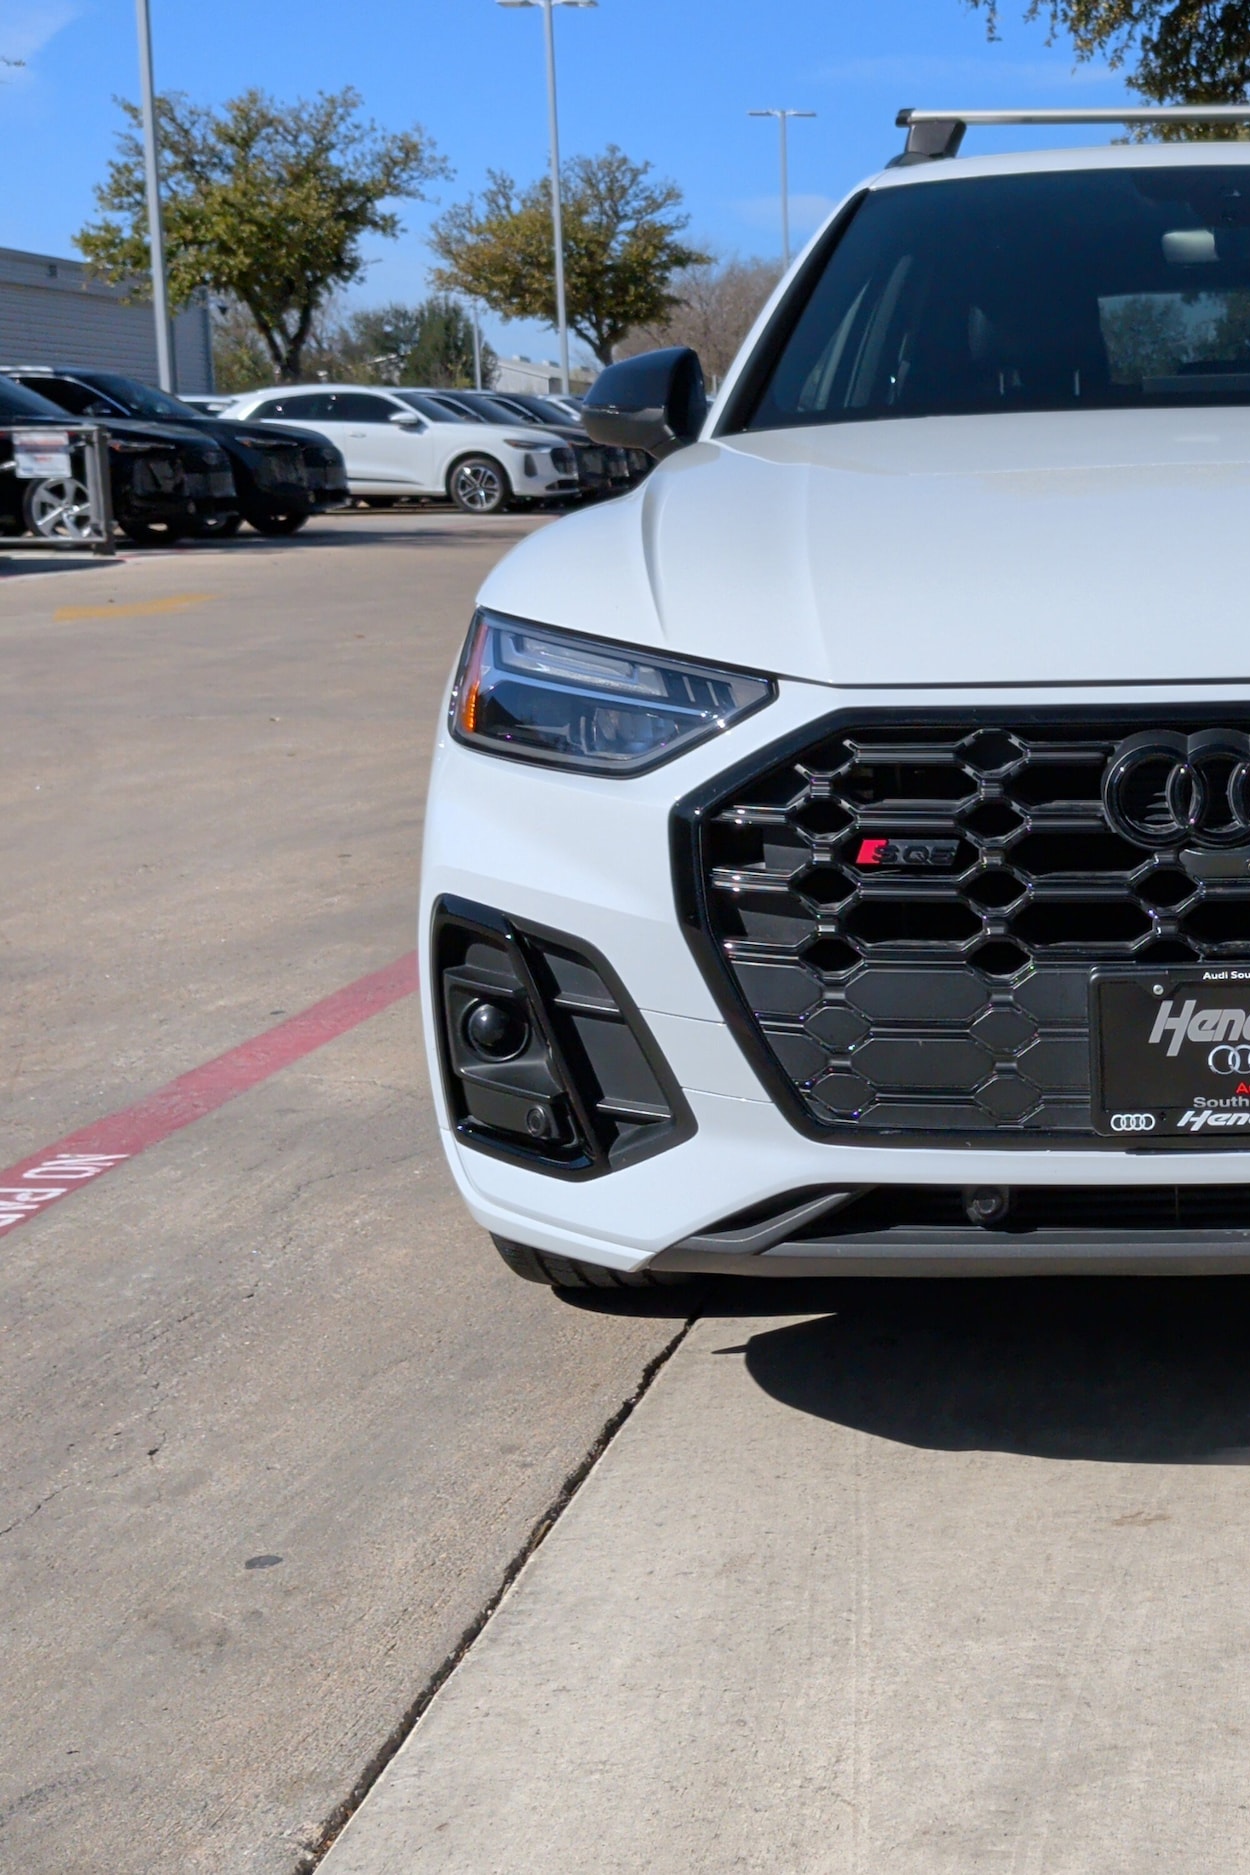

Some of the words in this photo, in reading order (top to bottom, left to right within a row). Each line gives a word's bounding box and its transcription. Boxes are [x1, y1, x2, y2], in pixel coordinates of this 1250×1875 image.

[870, 843, 956, 865] SQ5
[1202, 970, 1229, 980] Audi
[1193, 1096, 1250, 1108] South
[22, 1153, 130, 1179] NO
